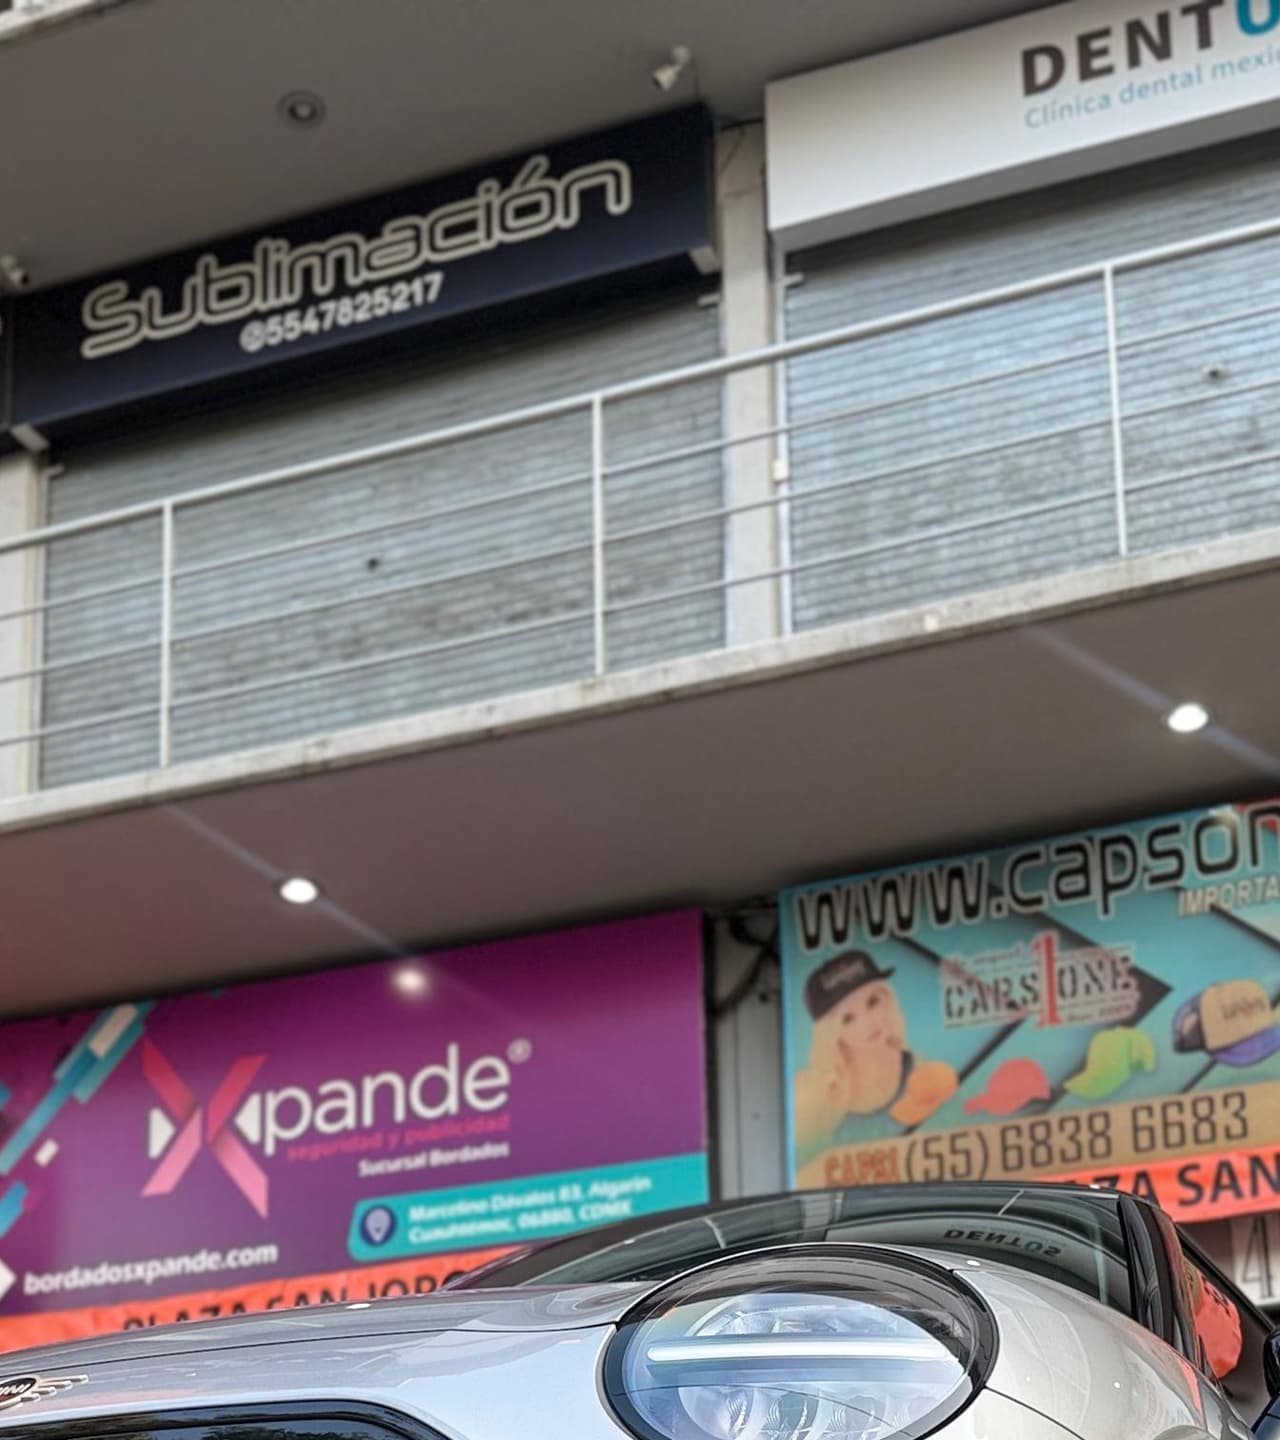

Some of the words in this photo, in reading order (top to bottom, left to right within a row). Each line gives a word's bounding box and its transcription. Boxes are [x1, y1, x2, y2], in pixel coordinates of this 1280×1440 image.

[1119, 65, 1204, 105] dental
[81, 155, 631, 359] Sublimación
[430, 1141, 510, 1168] Bordados
[905, 1130, 990, 1181] (55)
[1000, 1111, 1113, 1172] 6838
[1131, 1091, 1249, 1154] 6683
[23, 1243, 280, 1297] bordadosxpande.com
